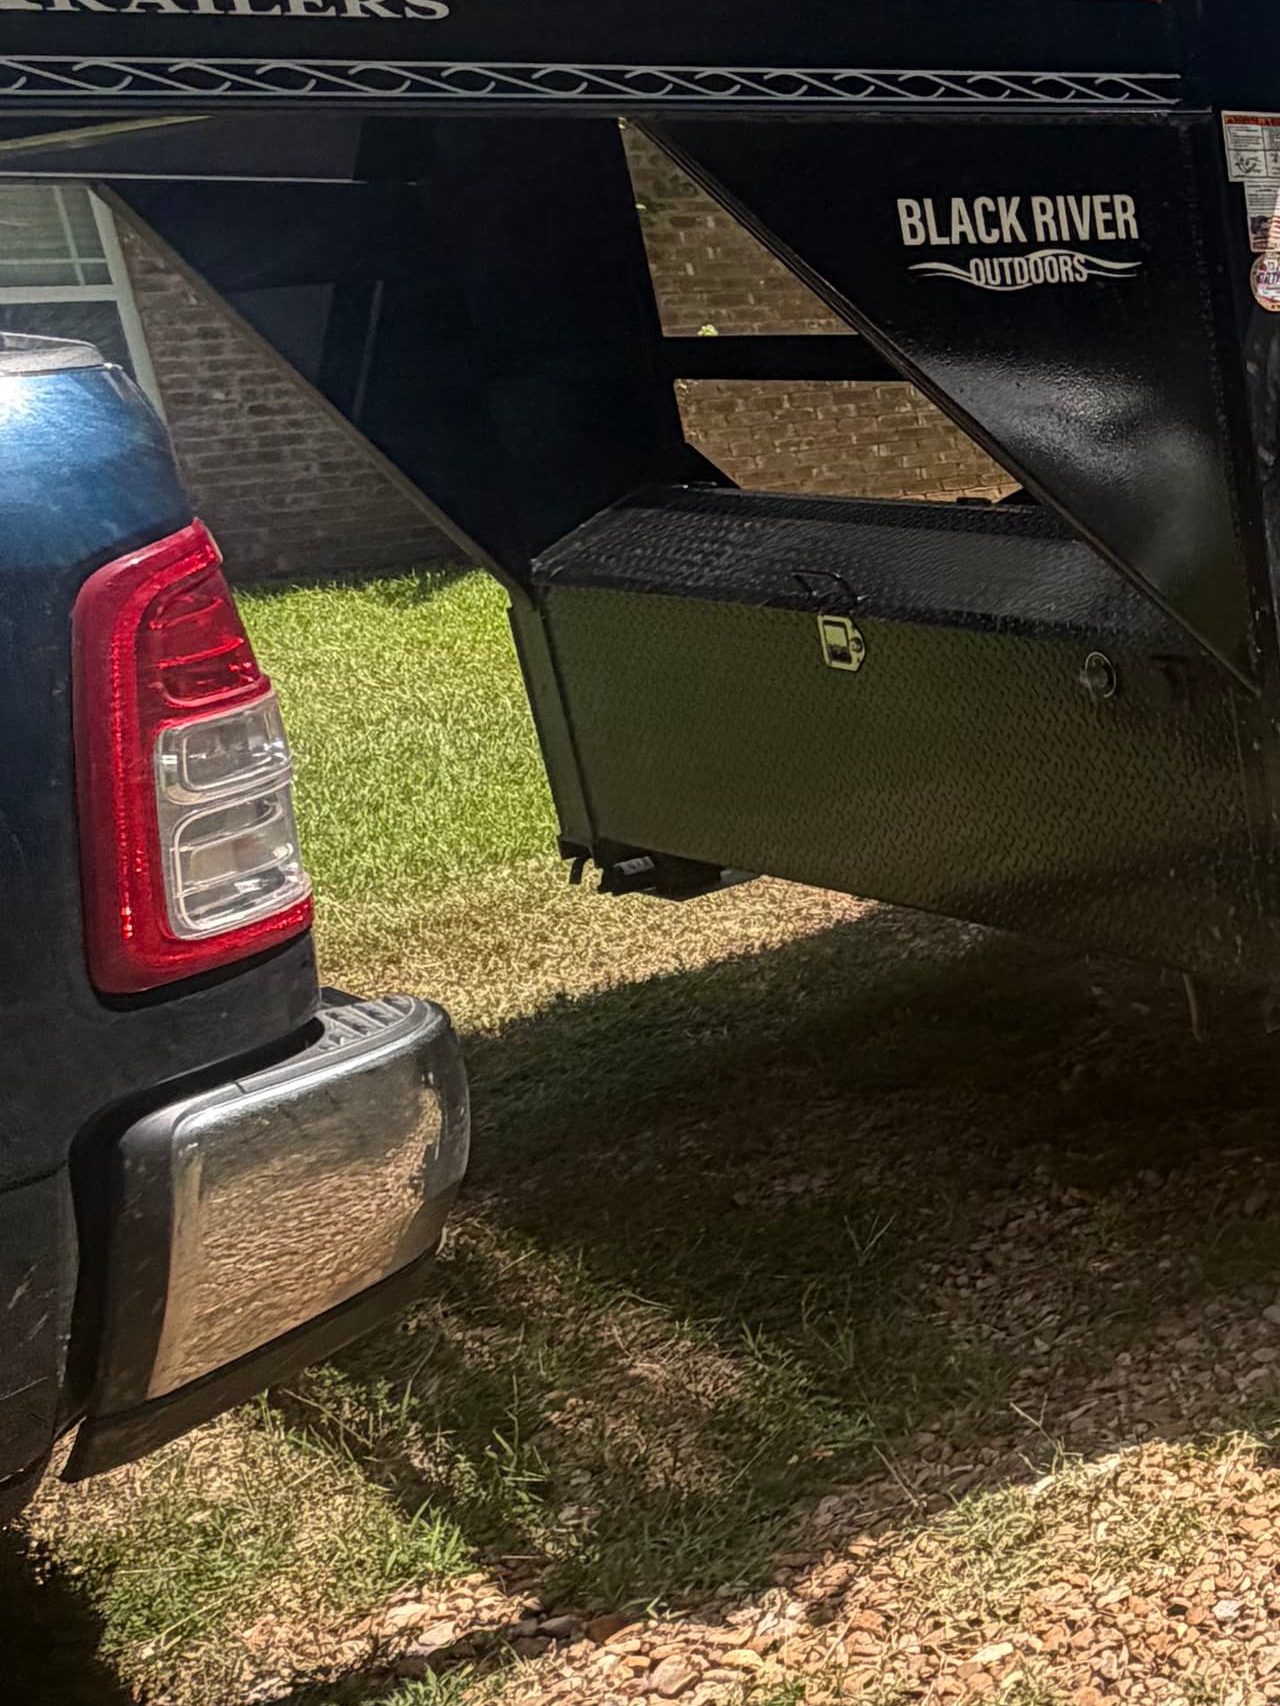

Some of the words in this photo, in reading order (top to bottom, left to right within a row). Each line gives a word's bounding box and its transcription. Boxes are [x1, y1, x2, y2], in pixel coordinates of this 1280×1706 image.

[897, 196, 1028, 246] BLACK
[1031, 194, 1139, 243] RIVER
[969, 254, 1088, 286] OUTDOORS
